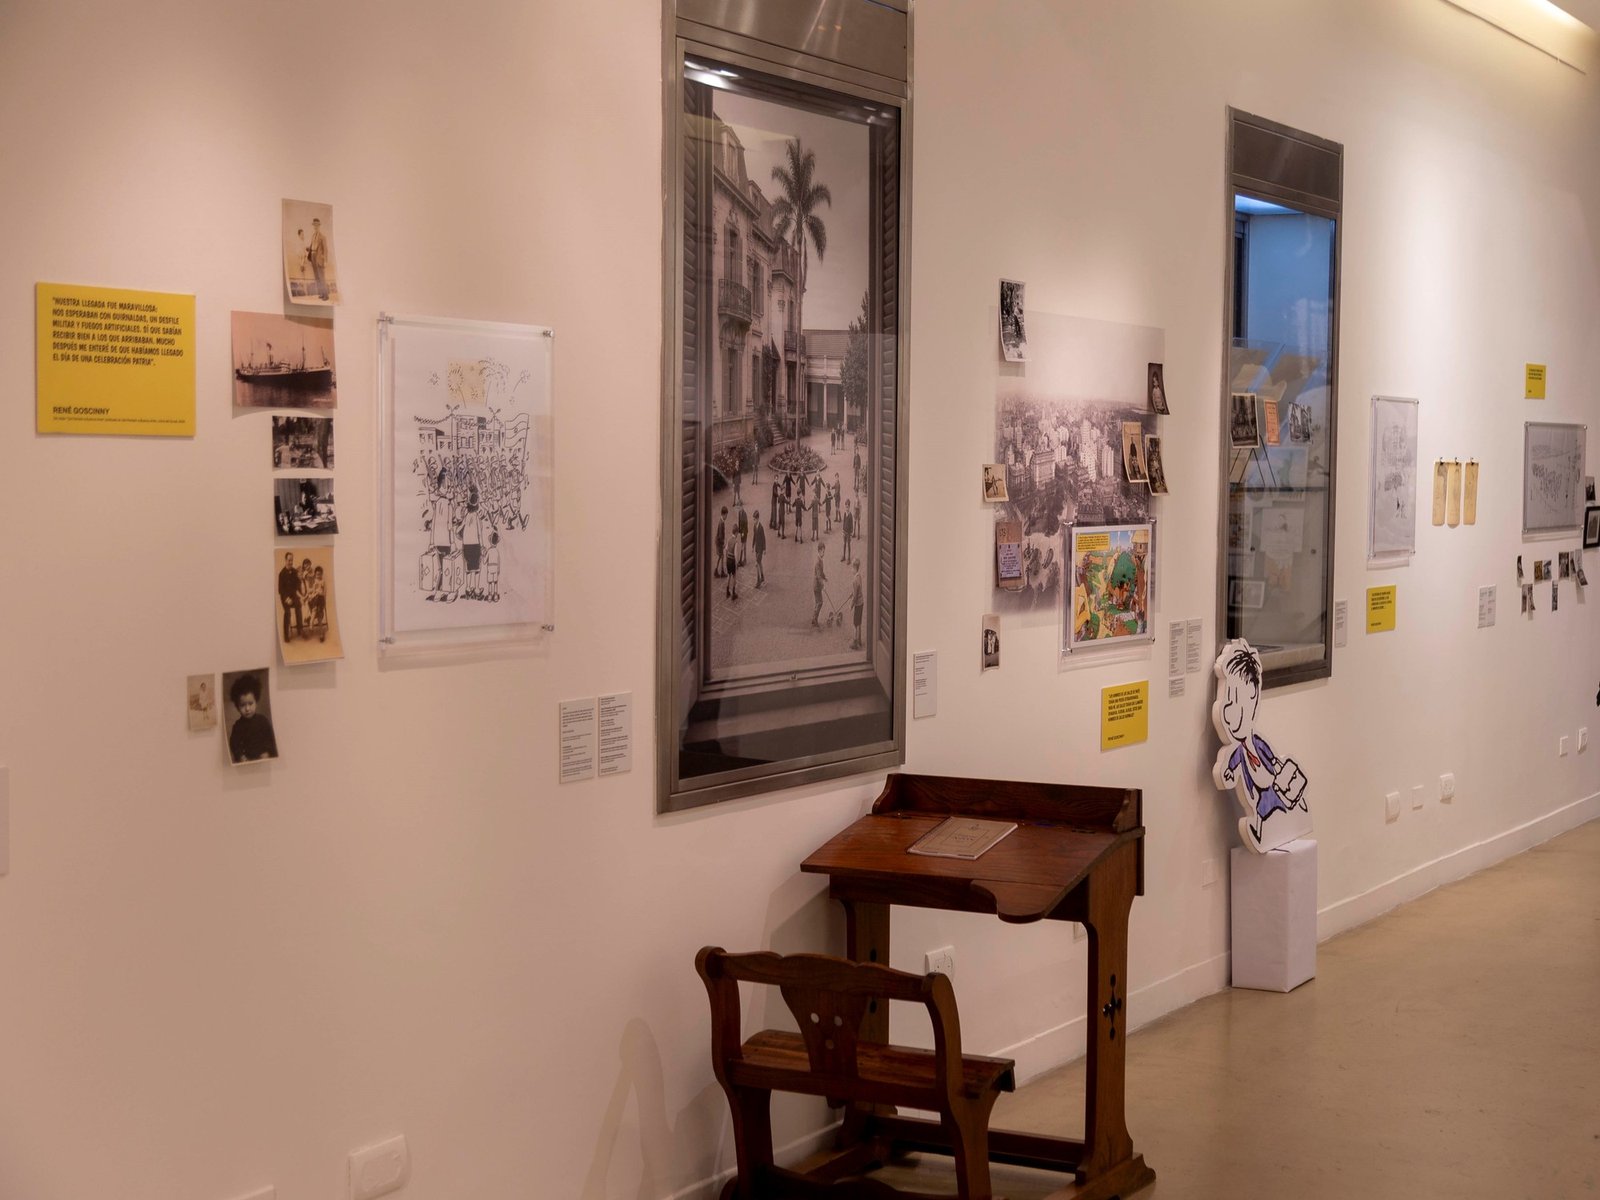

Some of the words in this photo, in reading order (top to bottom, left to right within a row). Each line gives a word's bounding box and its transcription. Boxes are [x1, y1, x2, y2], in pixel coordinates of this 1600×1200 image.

[66, 310, 98, 318] ESPERABAN
[159, 316, 179, 324] DESFILE
[53, 331, 75, 339] RECIBIR
[82, 322, 102, 330] FUEGOS
[162, 326, 182, 335] SABÍAN
[53, 342, 77, 350] DESPUÉS
[89, 344, 109, 352] ENTERÉ
[132, 346, 159, 355] HABÍAMOS
[161, 348, 183, 357] LLEGADO
[61, 352, 70, 361] DÍA
[94, 355, 131, 364] CELEBRACIÓN
